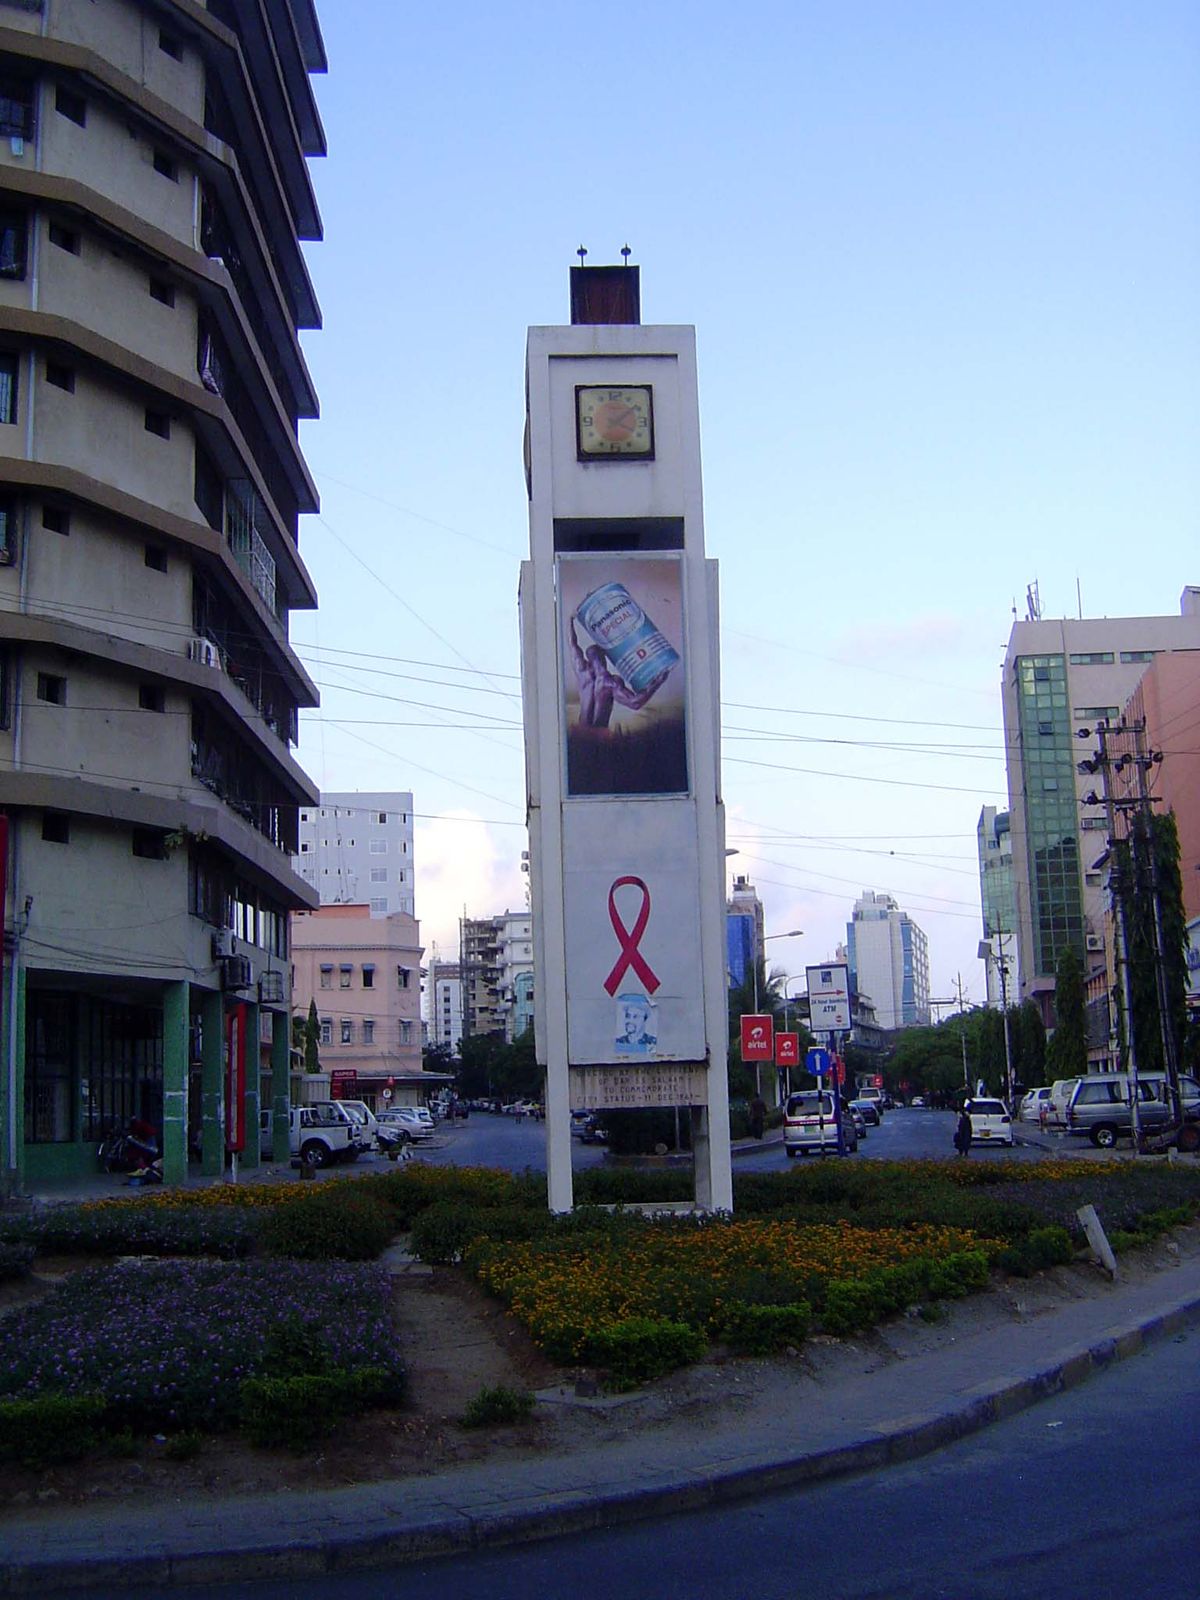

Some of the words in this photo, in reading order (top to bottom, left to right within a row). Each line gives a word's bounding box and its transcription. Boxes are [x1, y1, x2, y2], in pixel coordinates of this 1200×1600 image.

[608, 391, 622, 401] 12
[583, 416, 593, 427] 9
[639, 417, 648, 427] 3
[591, 599, 632, 632] Panasonic
[601, 611, 631, 638] SPECIAL
[636, 648, 647, 660] D
[823, 1005, 837, 1013] ATM
[748, 1040, 767, 1049] airtel
